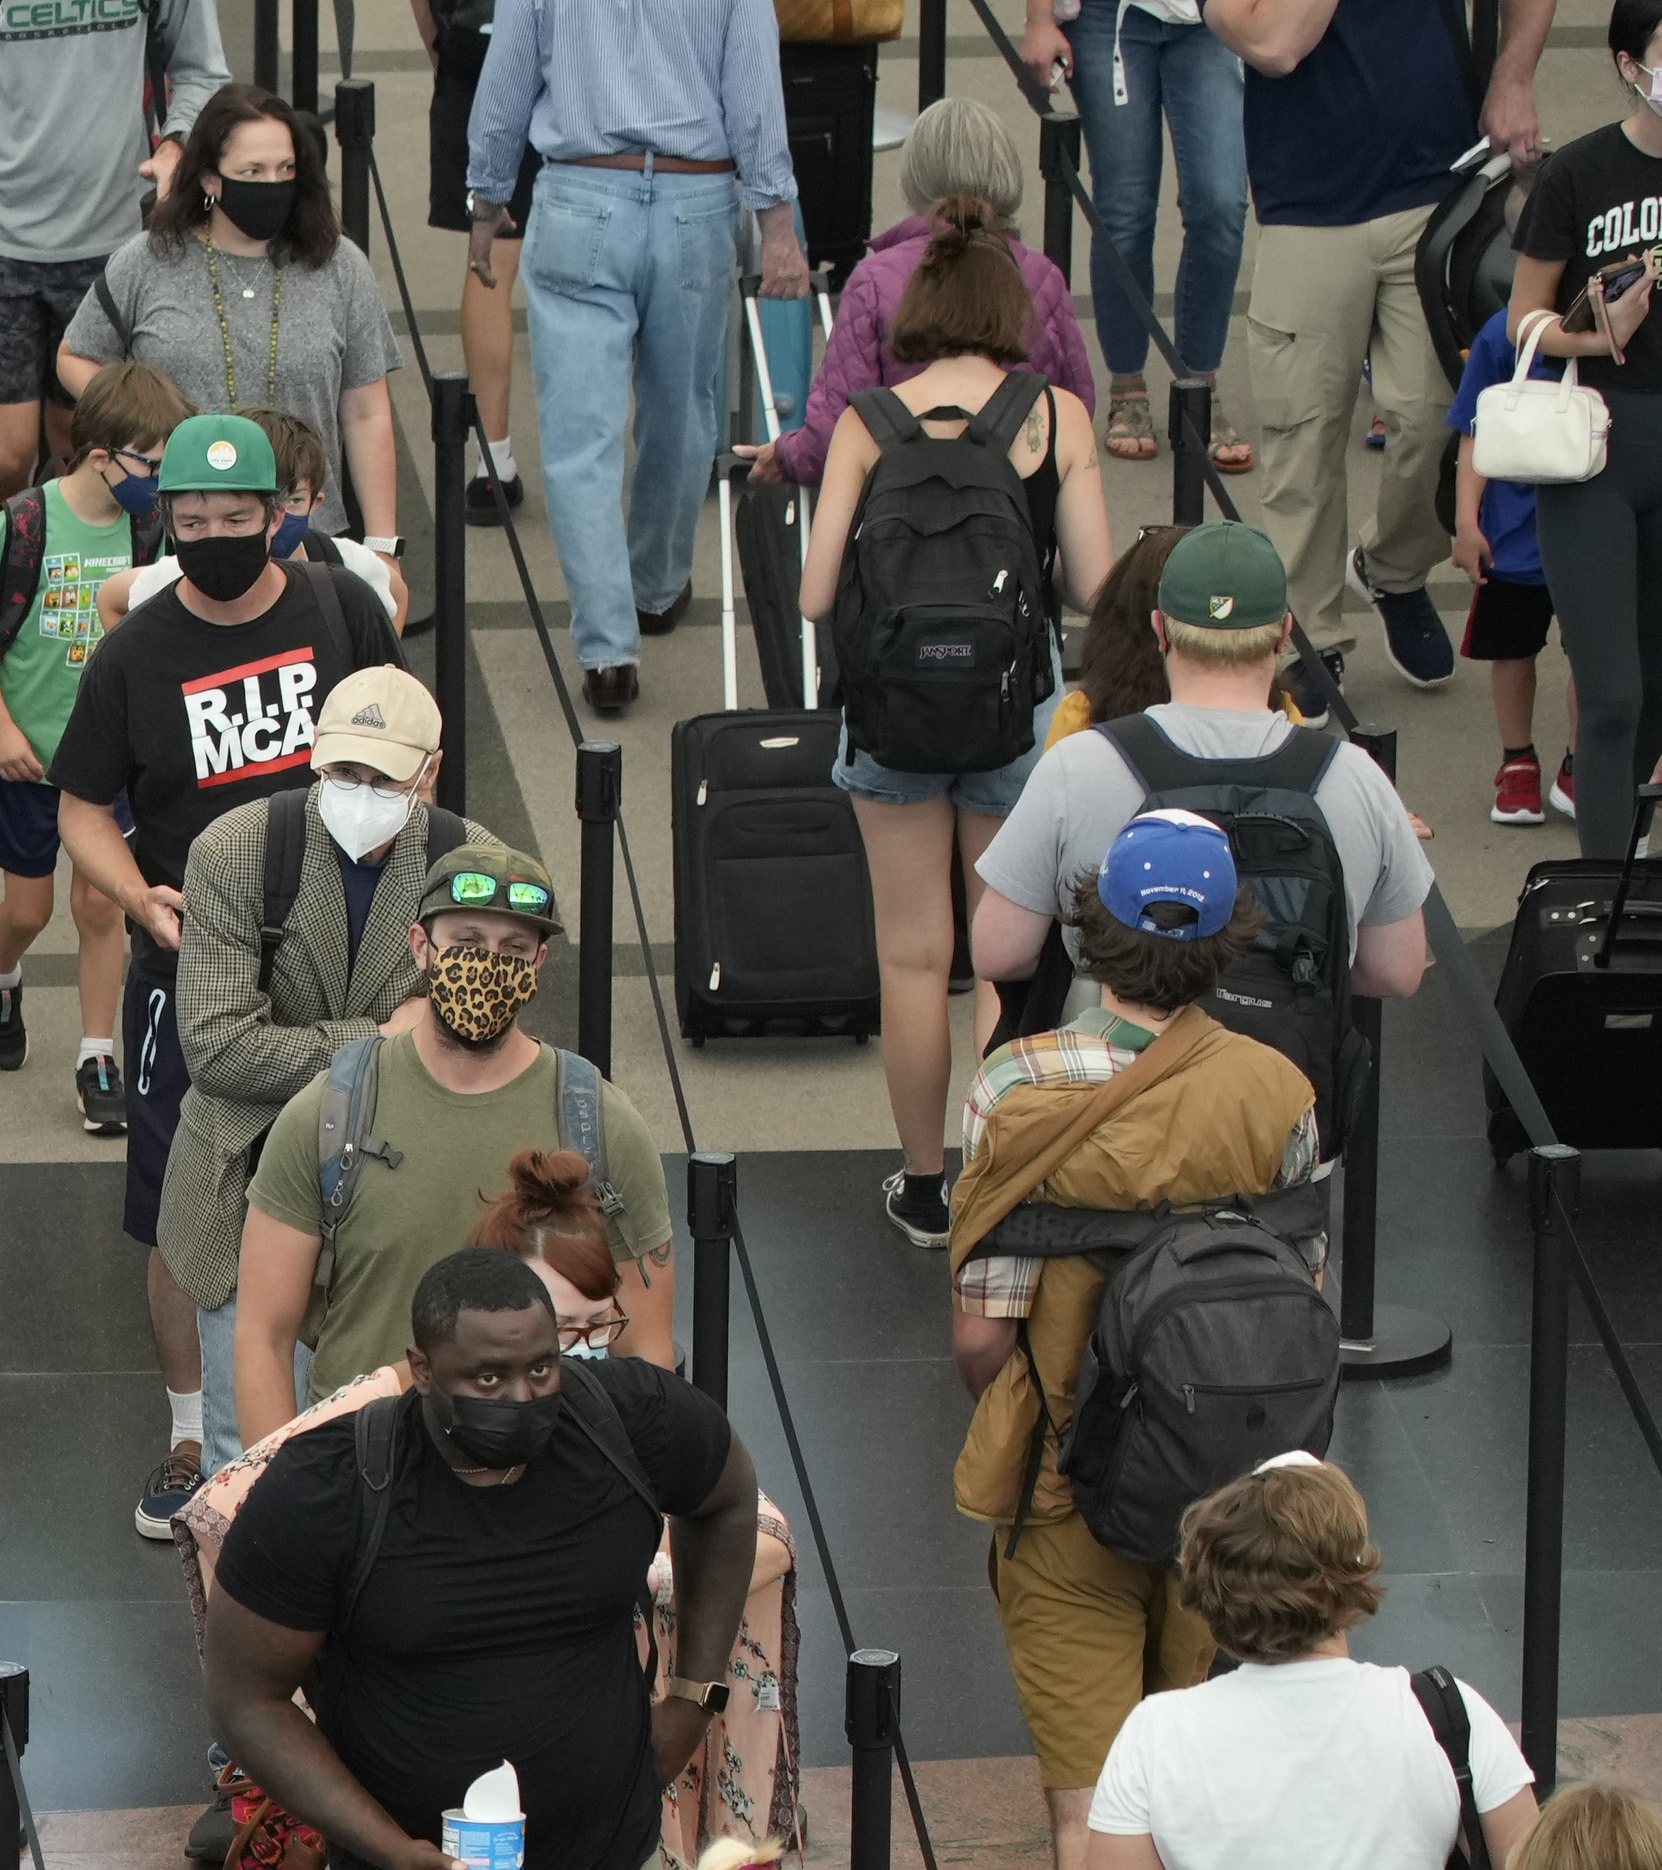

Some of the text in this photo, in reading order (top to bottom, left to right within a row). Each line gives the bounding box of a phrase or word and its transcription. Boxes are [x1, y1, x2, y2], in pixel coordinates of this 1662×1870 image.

[7, 0, 138, 27] CELTICS
[1586, 197, 1662, 258] COLO
[184, 662, 317, 739] R.I.P.
[351, 715, 387, 730] adidas
[192, 708, 315, 780] MCA
[1141, 885, 1179, 897] November
[1216, 987, 1273, 1009] Targus
